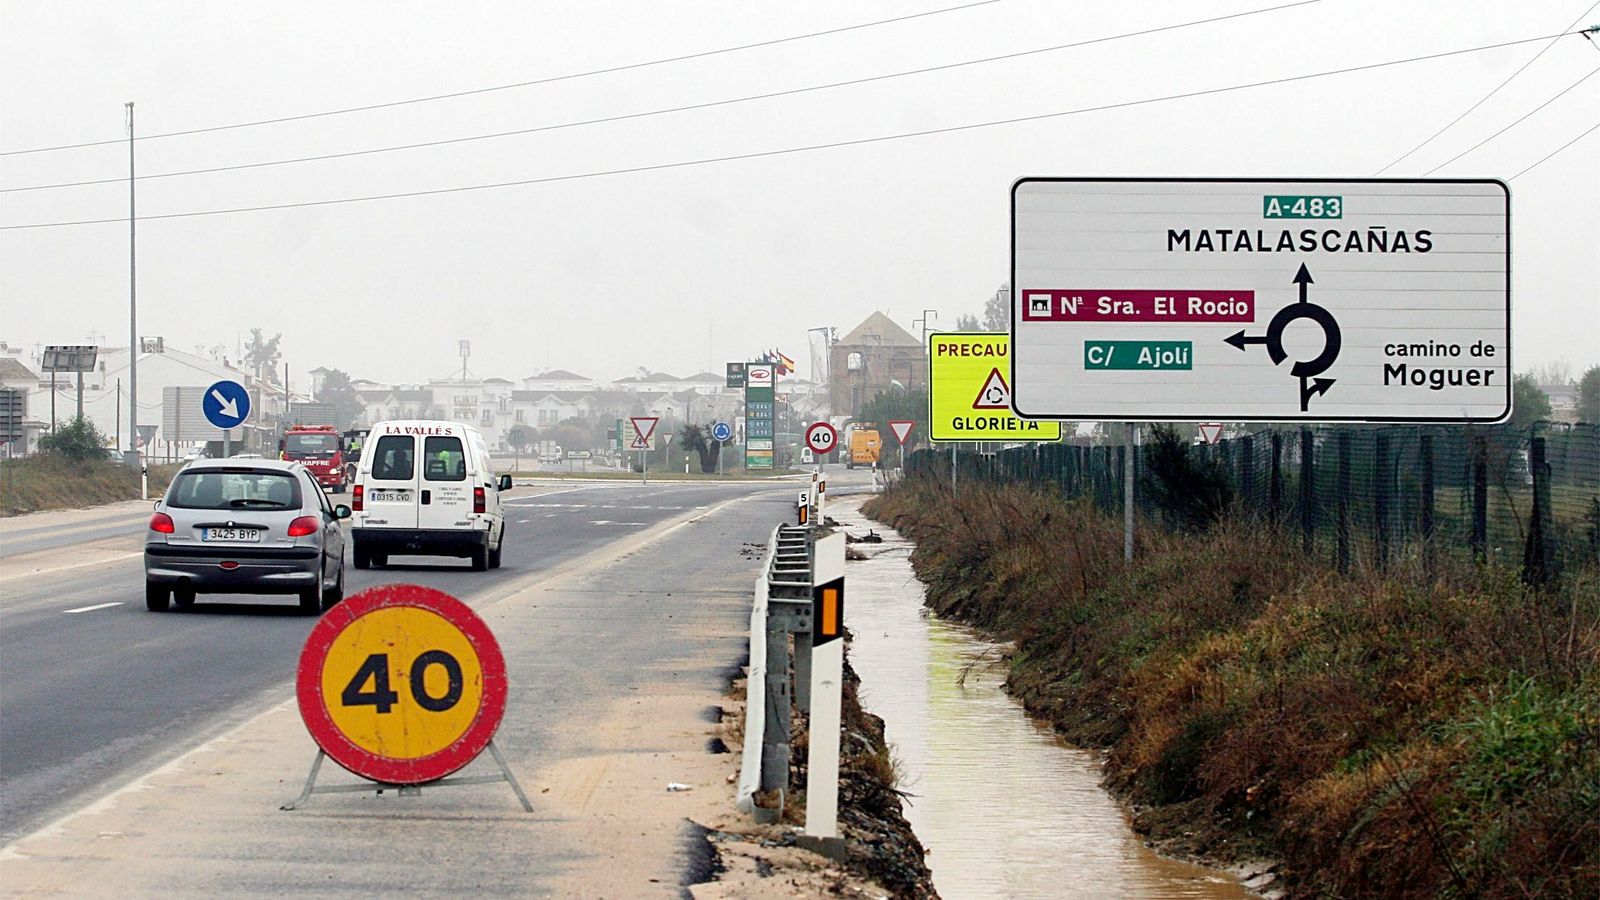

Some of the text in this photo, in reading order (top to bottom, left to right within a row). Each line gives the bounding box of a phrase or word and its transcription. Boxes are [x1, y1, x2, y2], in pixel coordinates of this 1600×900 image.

[1266, 197, 1341, 217] A-483
[1167, 225, 1433, 253] MATALASCAÑAS
[1096, 296, 1141, 315] Sra.
[1154, 296, 1177, 315] El
[1187, 296, 1248, 316] Rocio
[1087, 345, 1188, 369] C/ Ajolí
[1384, 340, 1495, 357] camino de
[1383, 364, 1495, 390] Moguer
[952, 416, 1039, 431] GLORIETA
[811, 432, 831, 444] 40
[376, 492, 394, 502] 0315
[800, 493, 807, 503] 5
[210, 529, 259, 541] 3425 BYP
[341, 649, 464, 714] 40
